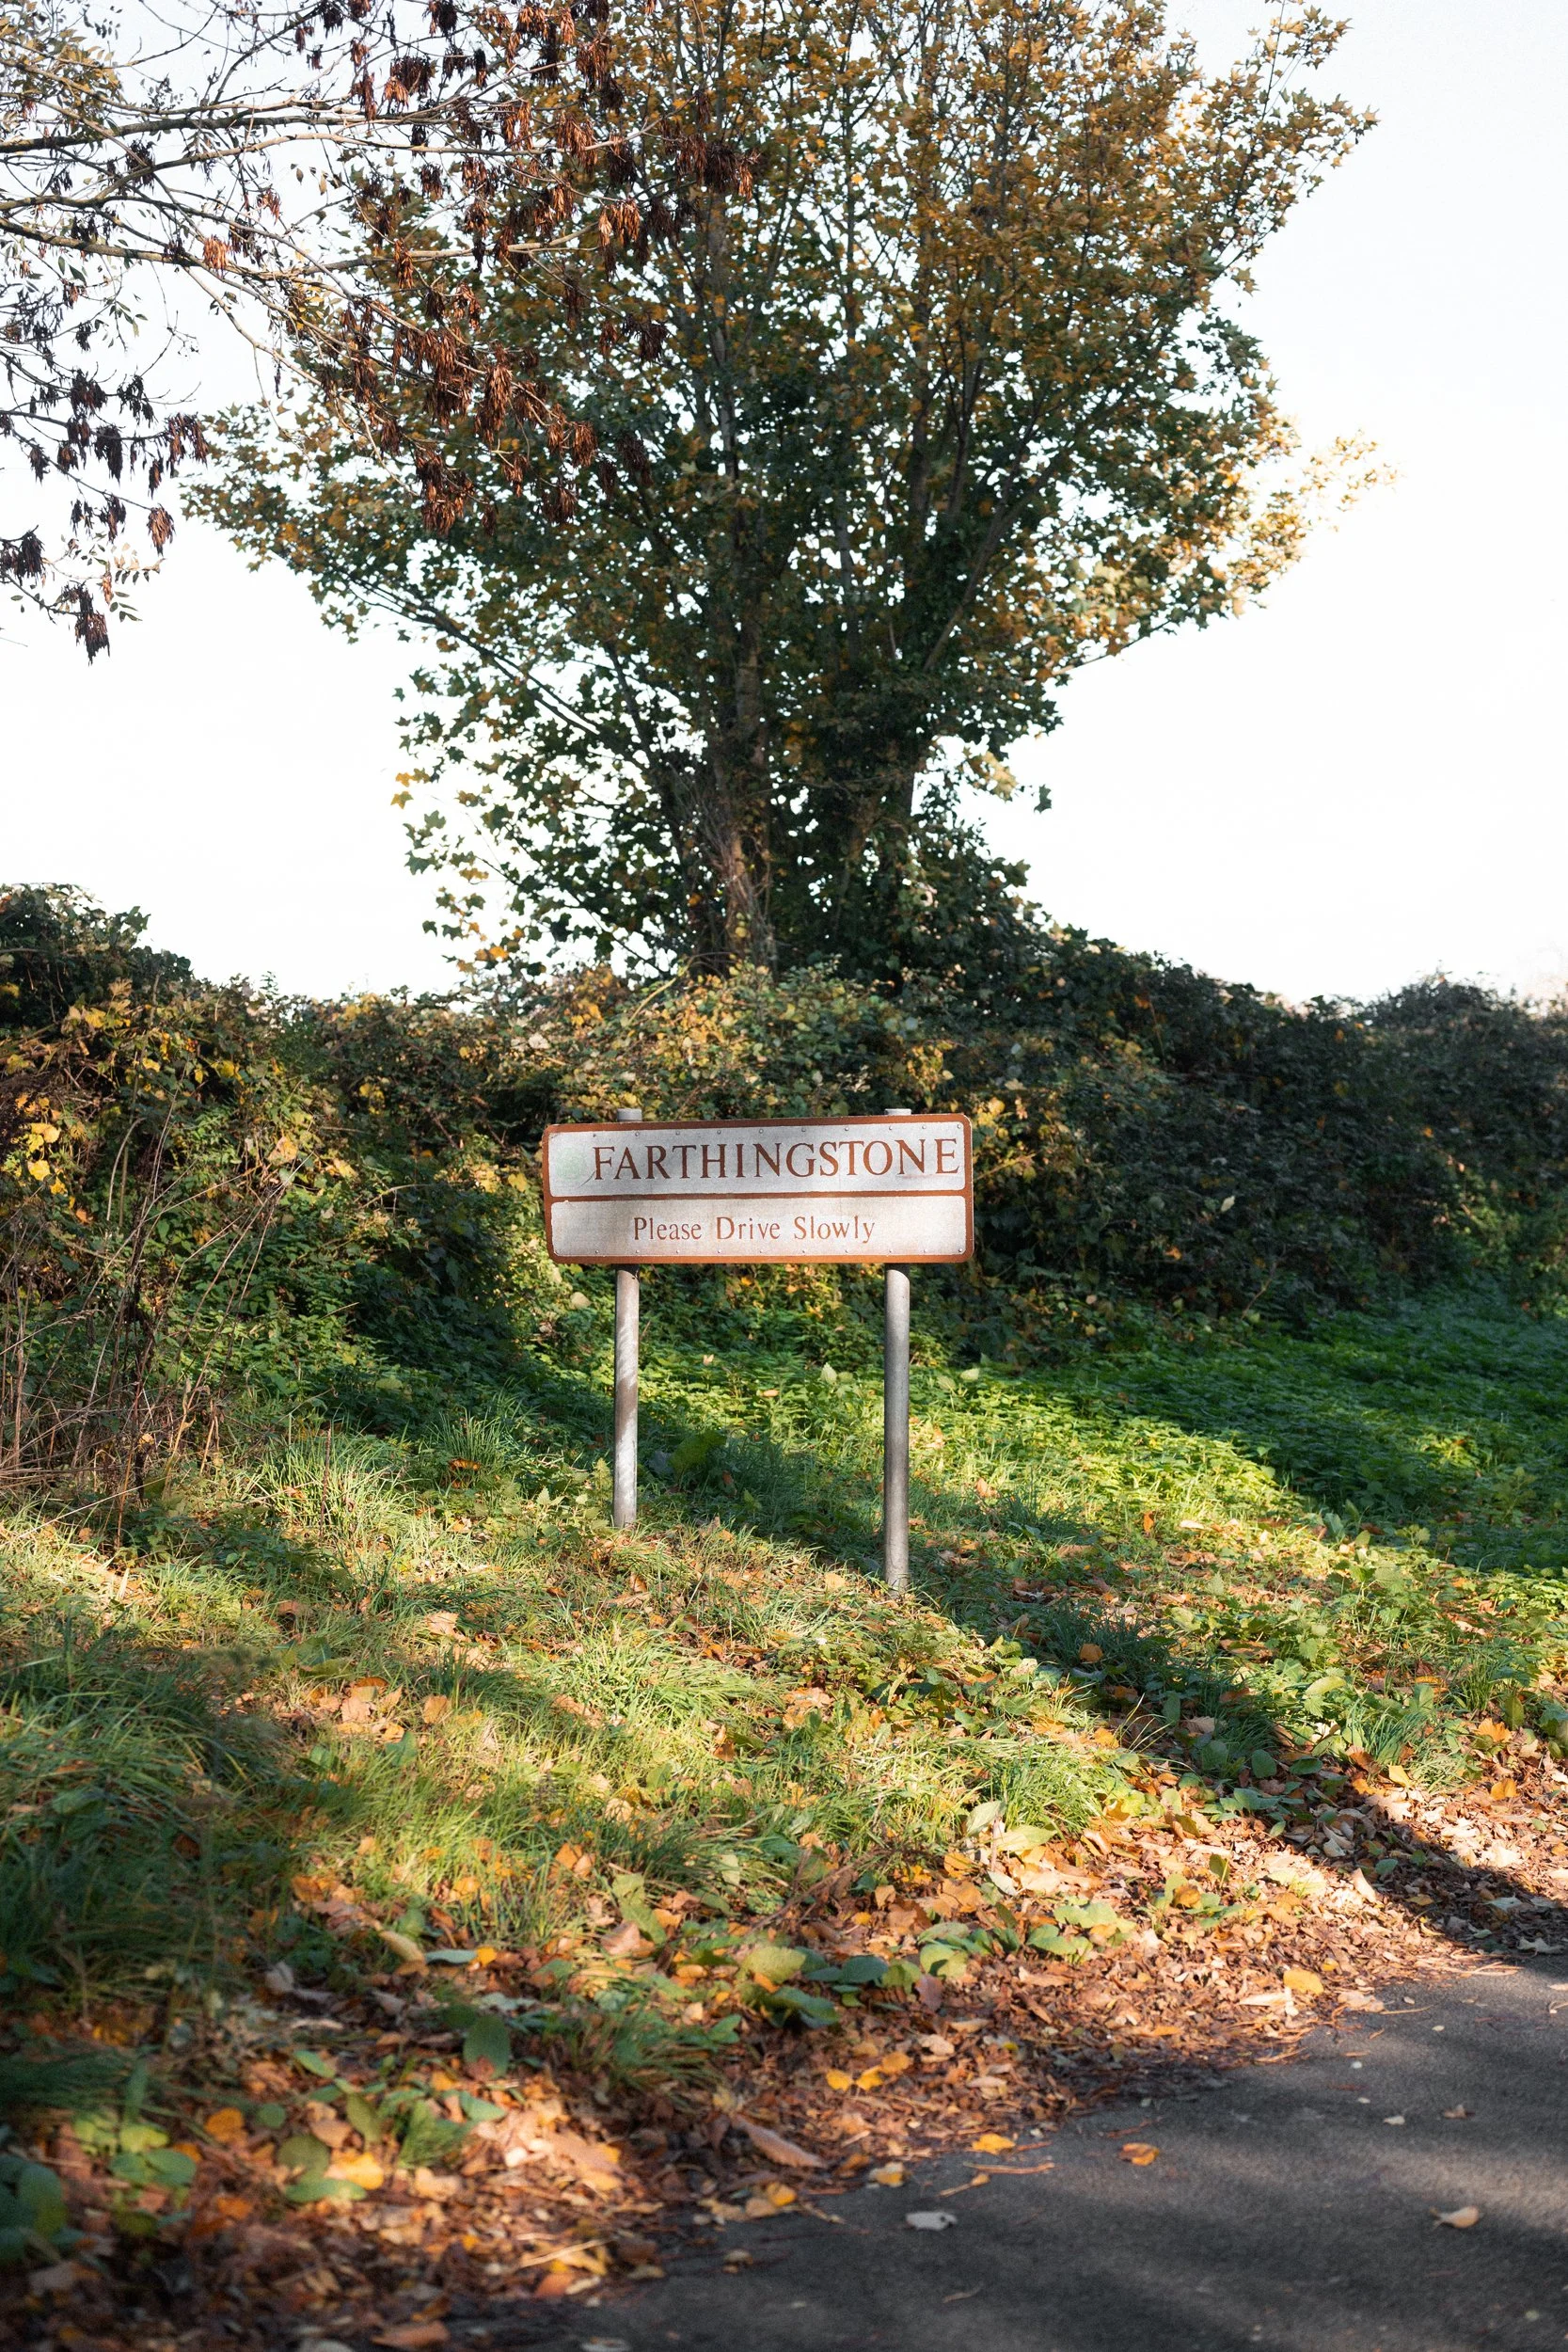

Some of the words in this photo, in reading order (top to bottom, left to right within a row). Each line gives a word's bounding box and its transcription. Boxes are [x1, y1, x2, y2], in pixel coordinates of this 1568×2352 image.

[593, 1137, 959, 1181] FARTHINGSTONE
[633, 1216, 702, 1241] Please
[716, 1216, 781, 1240] Drive
[794, 1216, 876, 1244] Slowly
